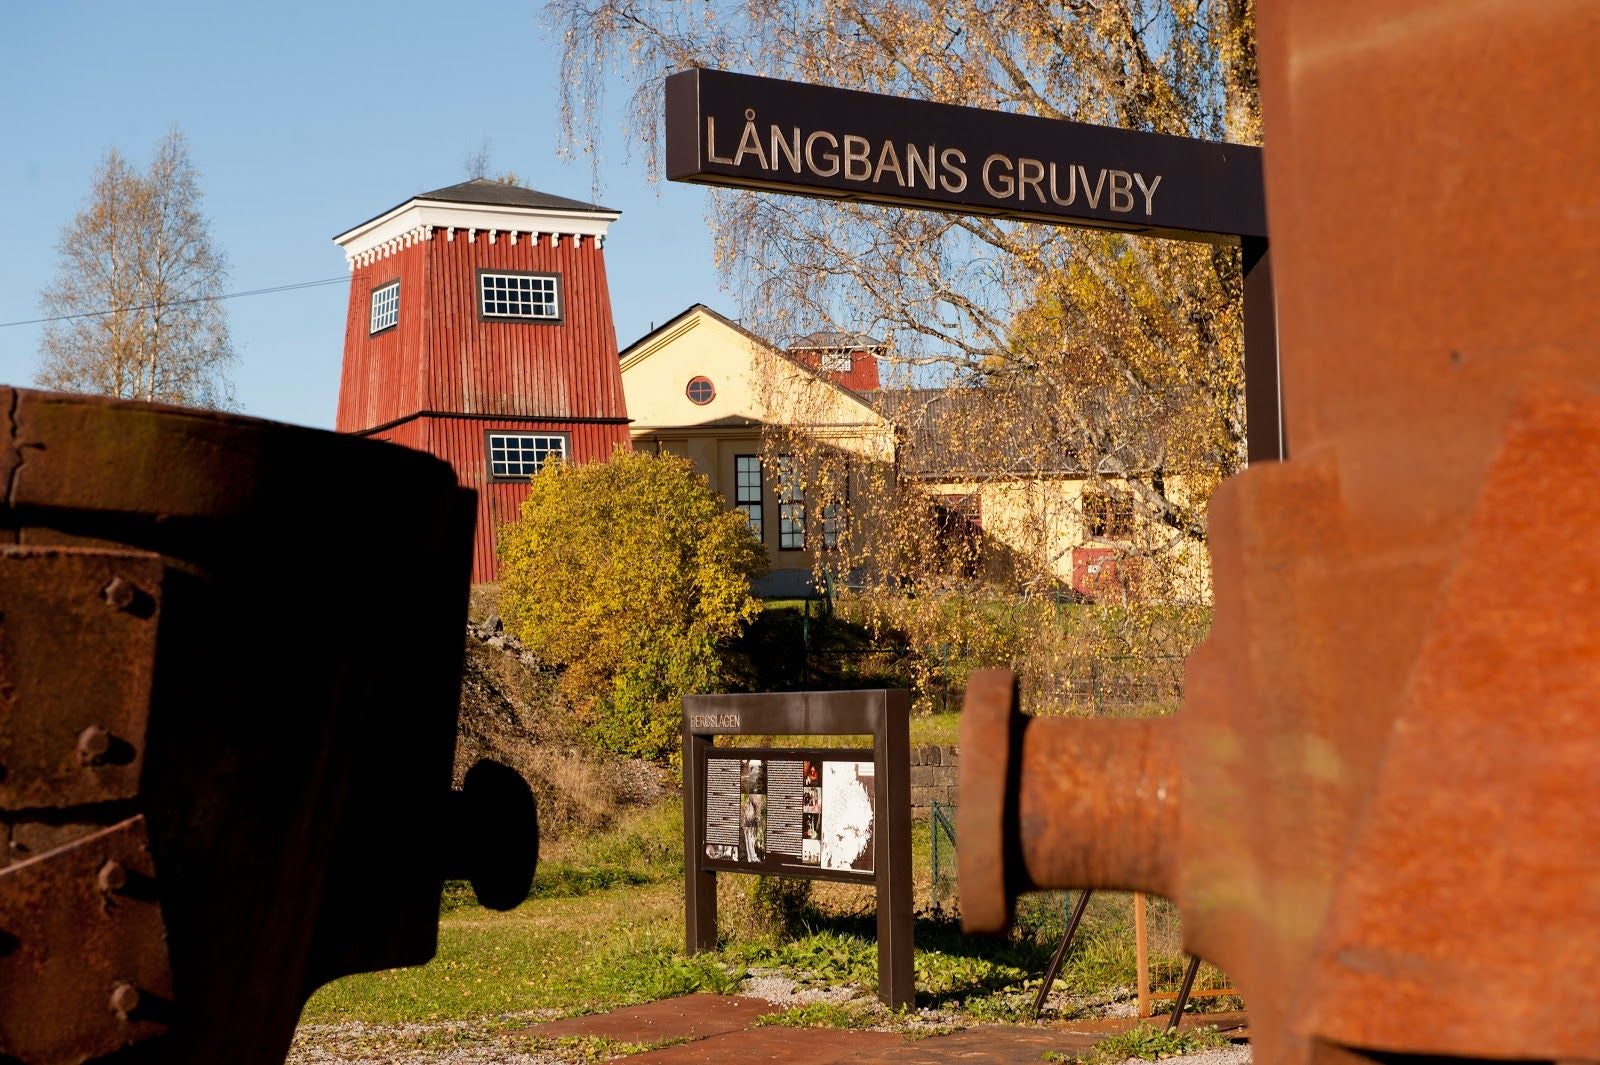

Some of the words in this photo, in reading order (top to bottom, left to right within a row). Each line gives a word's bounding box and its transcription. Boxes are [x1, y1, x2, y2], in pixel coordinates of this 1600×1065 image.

[707, 108, 968, 193] LÅNGBANS
[982, 153, 1162, 215] GRUVBY
[690, 714, 741, 728] BERGSLAGEN
